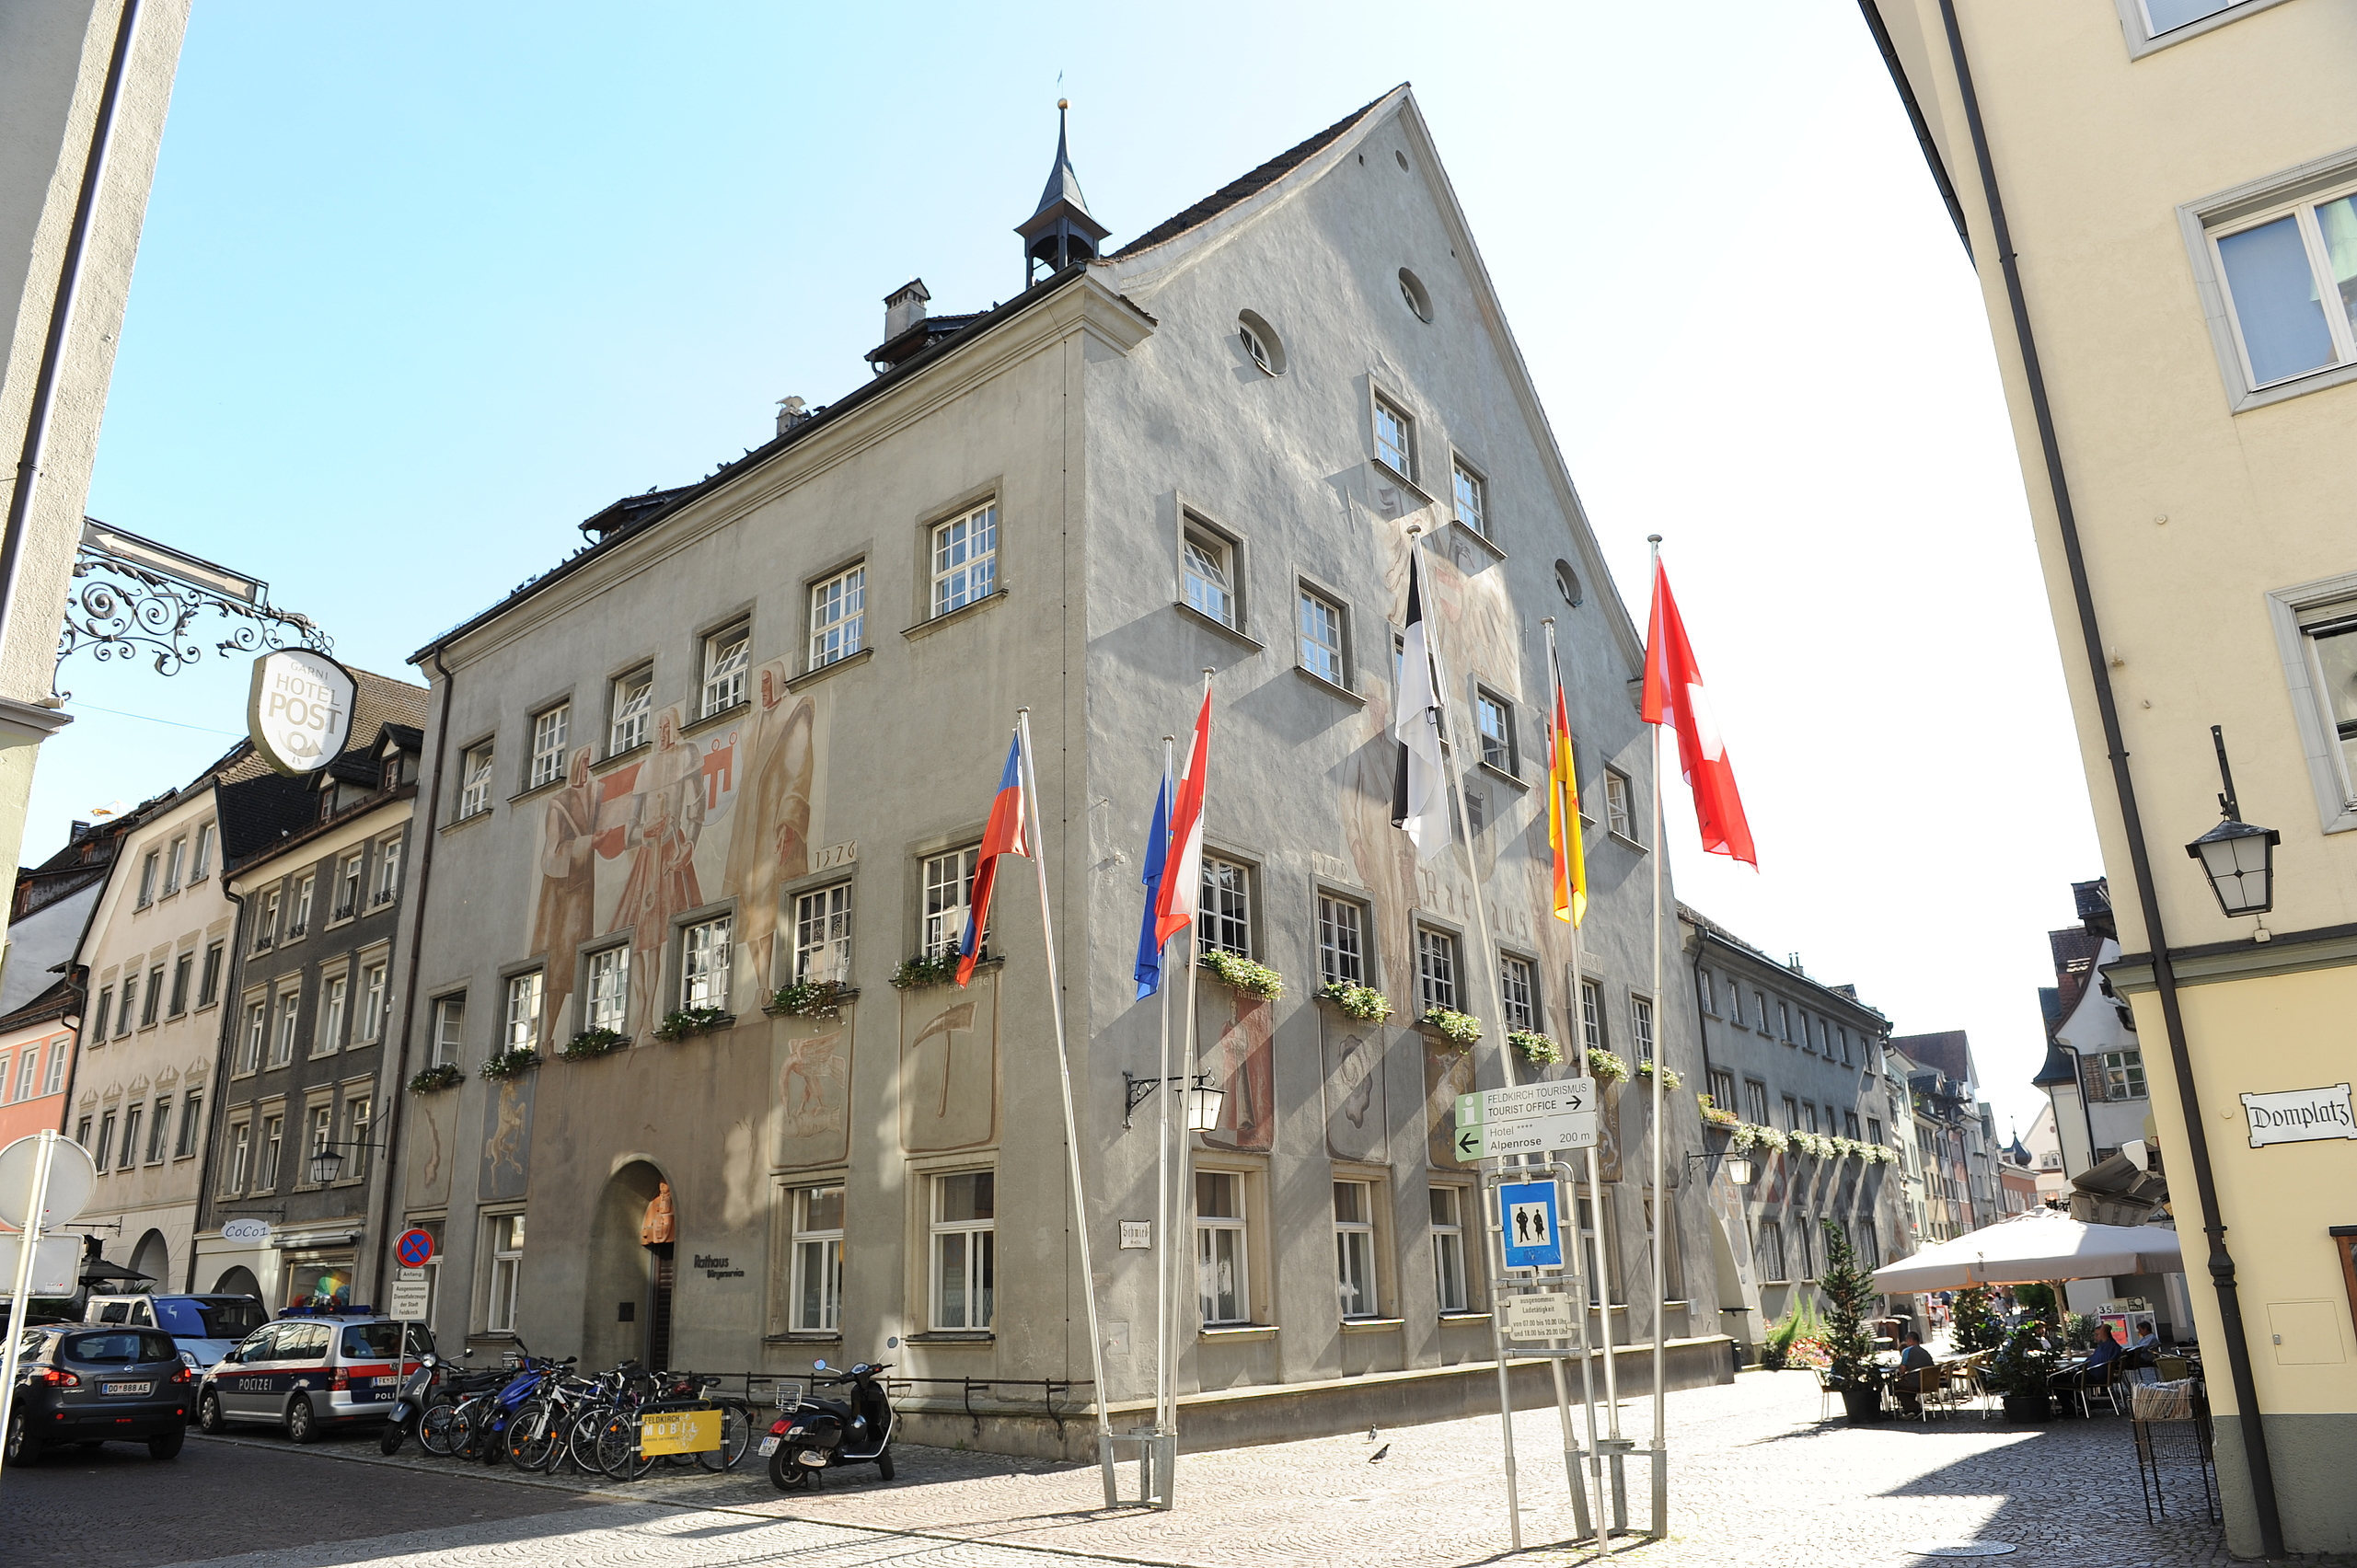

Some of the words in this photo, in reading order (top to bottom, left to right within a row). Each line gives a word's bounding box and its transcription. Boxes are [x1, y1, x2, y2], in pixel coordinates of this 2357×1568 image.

[290, 662, 329, 680] GARNI
[275, 673, 341, 706] HOTEL
[268, 691, 342, 734] POST
[815, 840, 856, 869] 1376
[1417, 865, 1529, 940] Rataus
[1487, 1090, 1534, 1104] FELDKIRCH
[1536, 1083, 1588, 1098] TOURISMUS
[1488, 1104, 1523, 1117] TOURIST
[1526, 1100, 1557, 1113] OFFICE
[2248, 1100, 2350, 1129] Domplatz
[1489, 1126, 1514, 1137] Hotel
[1490, 1137, 1542, 1151] Alpenrose
[1559, 1133, 1577, 1144] 200
[1580, 1132, 1590, 1141] m
[694, 1254, 729, 1268] Rathaus
[1522, 1306, 1555, 1314] Ladetätigkeit
[2098, 1306, 2112, 1314] 35
[238, 1378, 272, 1390] POLIZEI
[644, 1415, 680, 1424] FELDKIRCH
[644, 1422, 698, 1435] MOBIL
